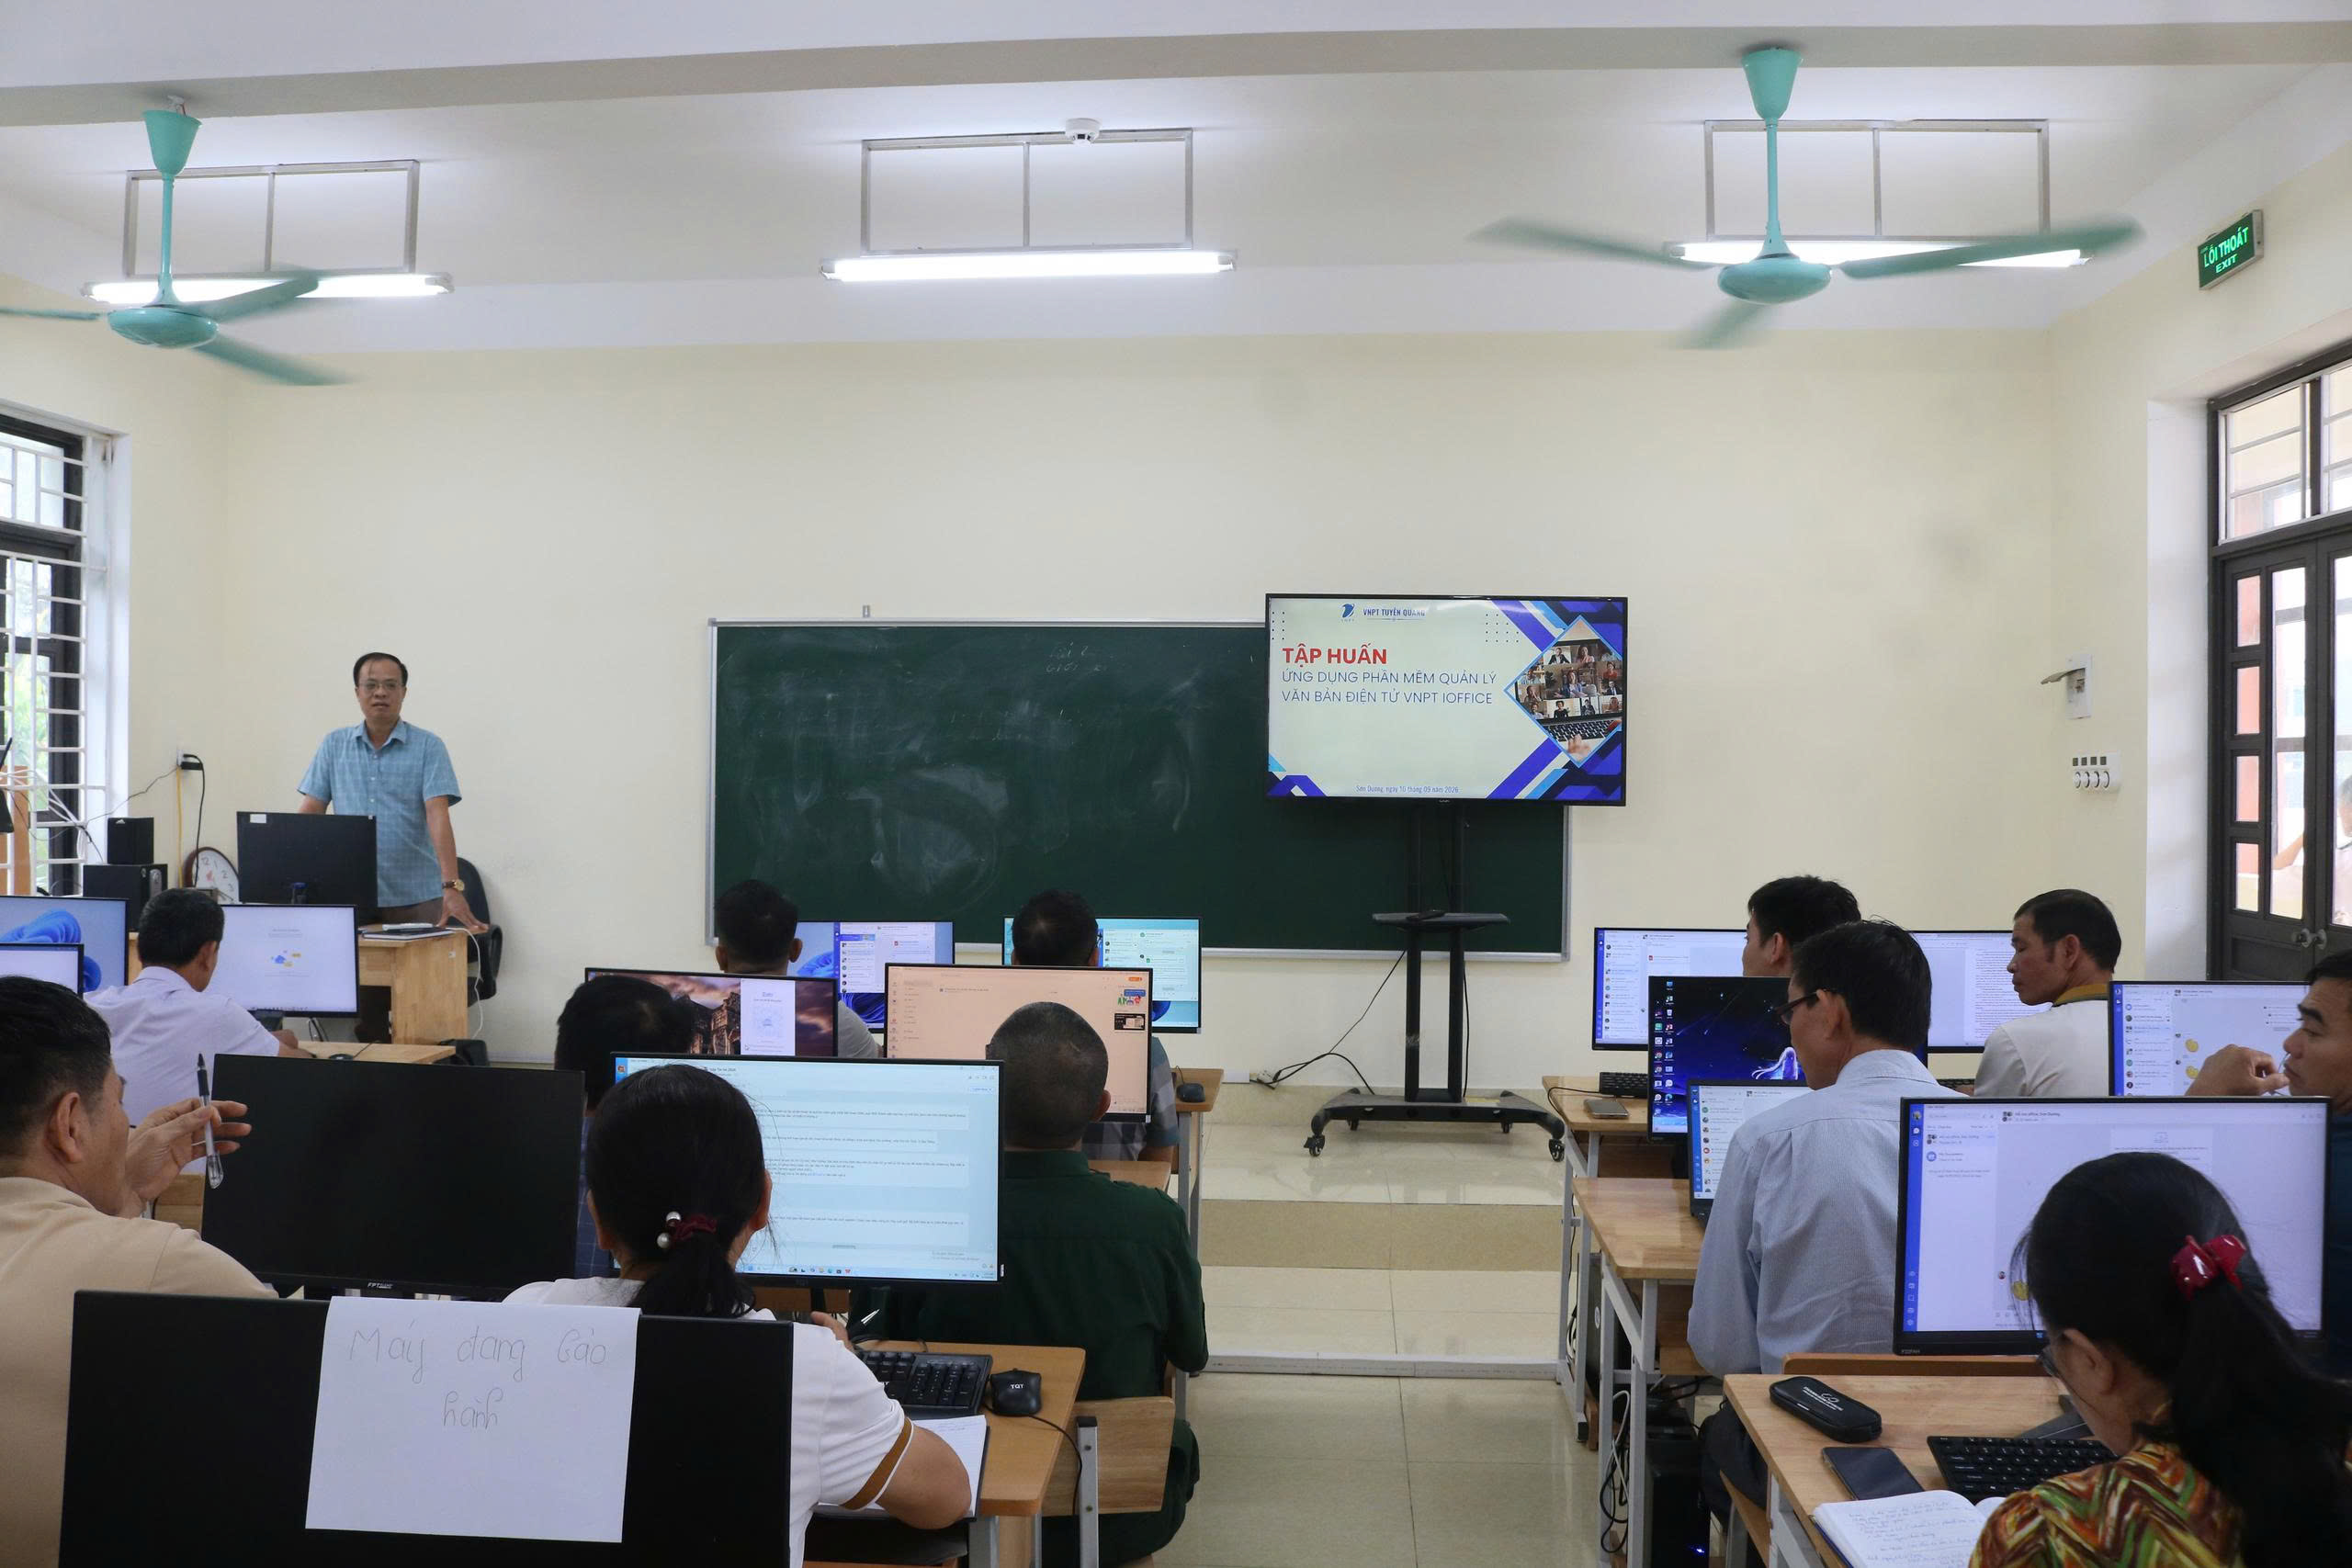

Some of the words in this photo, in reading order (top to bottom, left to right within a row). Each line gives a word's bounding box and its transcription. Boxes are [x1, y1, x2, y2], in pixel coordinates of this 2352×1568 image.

[2204, 244, 2218, 267] LỐI
[2218, 227, 2249, 257] THOÁT
[2215, 254, 2237, 273] EXIT
[1363, 608, 1379, 616] VNPT
[1381, 606, 1401, 616] TUYÊN
[1282, 643, 1322, 668] TẬP
[1327, 643, 1387, 665] HUẤN
[1282, 668, 1314, 682] ỨNG
[1317, 671, 1359, 684] DỤNG
[1363, 669, 1398, 683] PHẦN
[1403, 670, 1434, 683] MỀM
[1439, 670, 1478, 685] QUẢN
[1483, 671, 1497, 684] LÝ
[1282, 688, 1310, 702] VĂN
[1315, 687, 1341, 702] BẢN
[1346, 688, 1376, 705] ĐIỆN
[1381, 687, 1400, 704] TỬ
[1404, 692, 1439, 704] VNPT
[1442, 692, 1492, 705] IOFFICE
[349, 1319, 425, 1384] Máy
[457, 1325, 526, 1383] đang
[443, 1387, 503, 1430] hành
